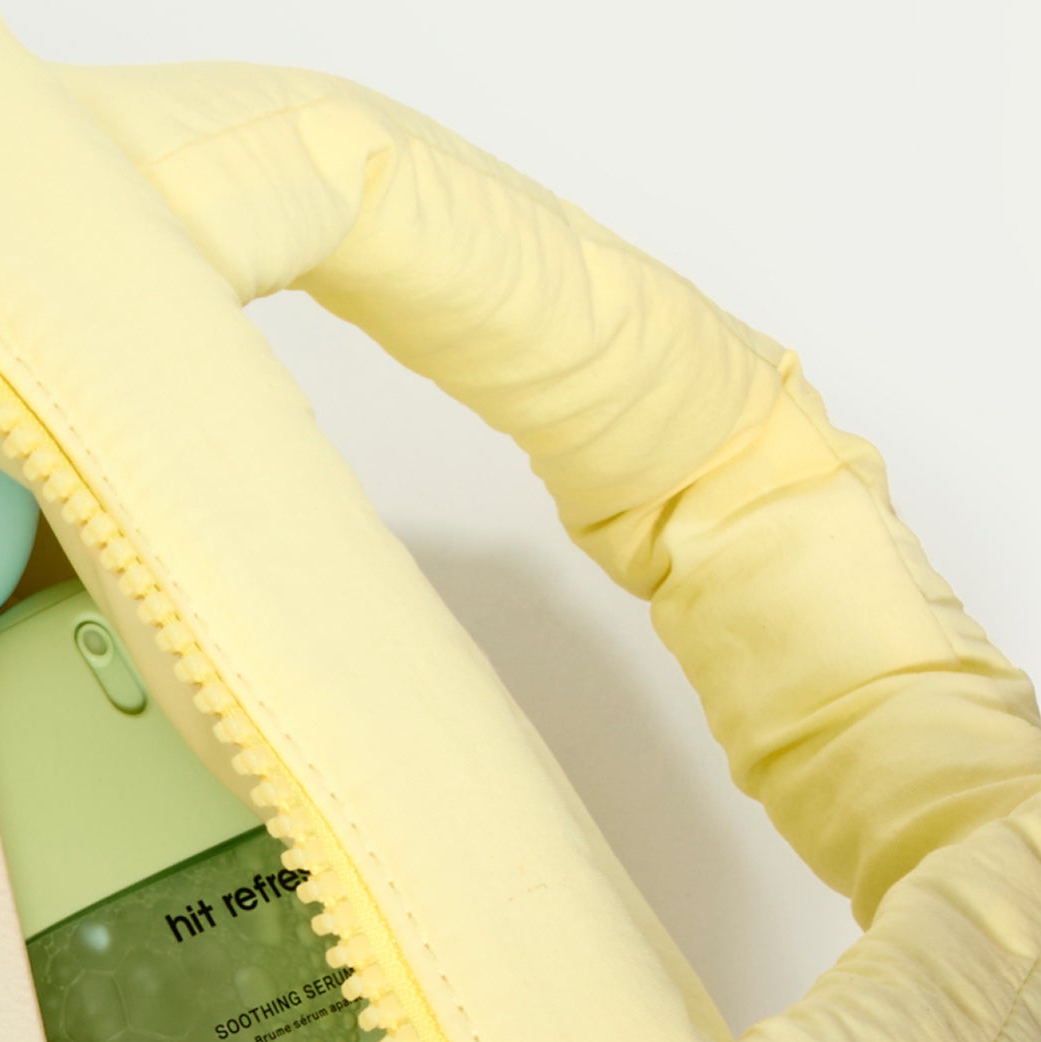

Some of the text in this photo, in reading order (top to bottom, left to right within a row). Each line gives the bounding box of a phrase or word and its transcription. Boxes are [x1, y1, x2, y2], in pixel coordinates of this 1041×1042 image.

[164, 899, 217, 943] hit
[214, 990, 303, 1040] SOOTHING
[292, 1007, 329, 1030] sérum
